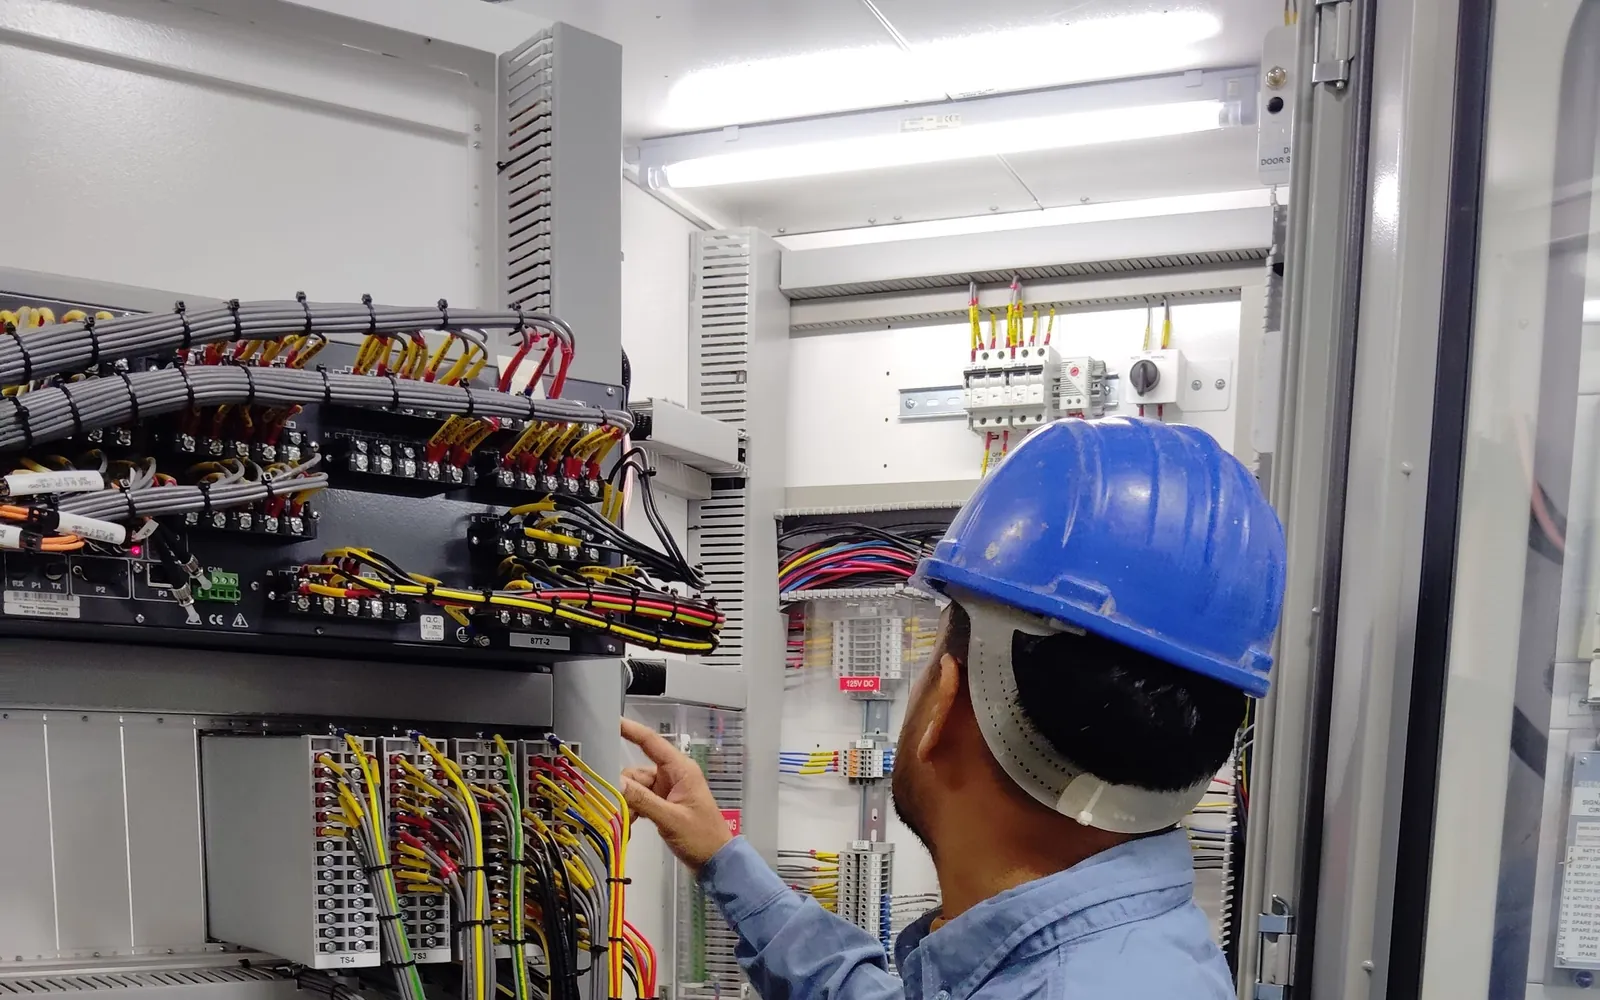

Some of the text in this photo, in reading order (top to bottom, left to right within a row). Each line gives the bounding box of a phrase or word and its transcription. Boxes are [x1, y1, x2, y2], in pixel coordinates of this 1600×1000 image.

[1260, 156, 1285, 166] DOOR
[12, 580, 24, 588] RX
[31, 581, 41, 589] P1
[51, 582, 62, 590] TX
[95, 586, 106, 594] P2
[530, 637, 551, 646] 87T-2
[846, 679, 874, 688] 125V DC
[339, 956, 355, 964] TS4
[413, 952, 427, 960] TS3
